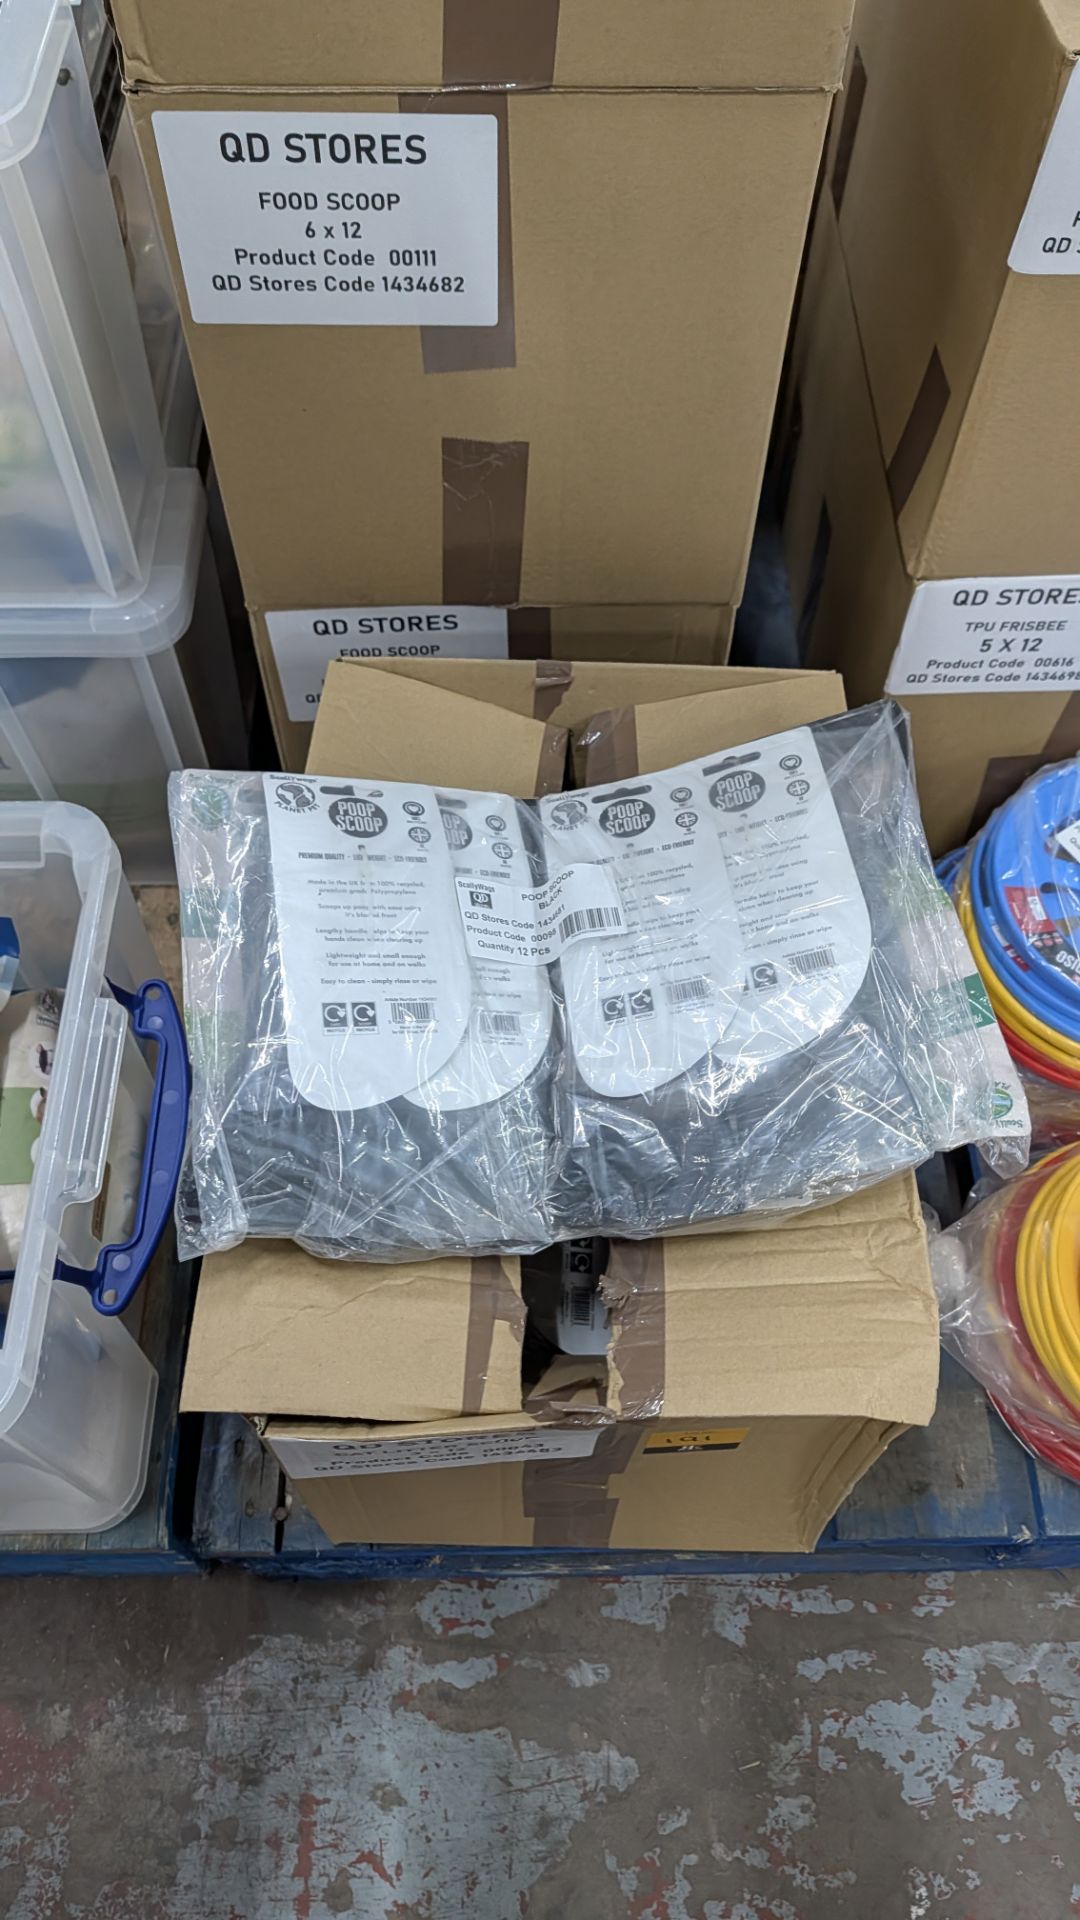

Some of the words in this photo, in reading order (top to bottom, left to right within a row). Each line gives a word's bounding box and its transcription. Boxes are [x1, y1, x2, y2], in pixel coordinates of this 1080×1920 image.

[219, 132, 270, 163] QD
[285, 133, 427, 165] STORES
[259, 192, 318, 211] FOOD
[327, 192, 401, 211] SCOOP
[305, 221, 316, 239] 6
[342, 222, 362, 239] 12
[1042, 237, 1072, 254] QD
[234, 248, 317, 266] Product
[324, 249, 375, 267] Code
[389, 249, 437, 267] 00111
[212, 275, 242, 292] QD
[250, 275, 317, 292] Stores
[324, 276, 375, 293] Code
[382, 276, 465, 293] 1434682
[953, 589, 989, 607] QD
[996, 588, 1080, 606] STORE
[313, 618, 348, 636] QD
[358, 614, 459, 635] STORES
[965, 621, 996, 633] TPU
[999, 620, 1069, 633] FRISBEE
[340, 647, 382, 659] FOOD
[388, 645, 440, 659] SCOOP
[979, 638, 993, 653] 5
[1020, 637, 1044, 653] 12
[926, 658, 984, 670] Product
[988, 658, 1025, 669] Code
[1034, 657, 1075, 668] 00616
[906, 673, 928, 684] QD
[931, 673, 980, 683] Stores
[985, 672, 1021, 683] Code
[716, 771, 753, 795] POOP
[714, 784, 761, 811] SCOOP
[337, 800, 376, 817] POOP
[607, 800, 645, 820] POOP
[335, 816, 384, 834] SCOOP
[605, 813, 651, 836] SCOOP
[521, 890, 548, 901] POOP
[549, 870, 574, 893] SCOOP
[539, 886, 563, 910] BLACK
[465, 911, 479, 920] QD
[481, 913, 510, 926] Stores
[511, 918, 534, 930] Code
[466, 925, 502, 938] Product
[504, 931, 526, 943] Code
[477, 939, 515, 955] Quantity
[517, 946, 529, 956] 12
[531, 947, 551, 956] Pcs
[332, 1443, 383, 1451] QD
[396, 1431, 537, 1447] STORES
[330, 1456, 411, 1465] Product
[418, 1451, 470, 1459] Code
[350, 1461, 418, 1469] Stores
[425, 1455, 475, 1463] Code
